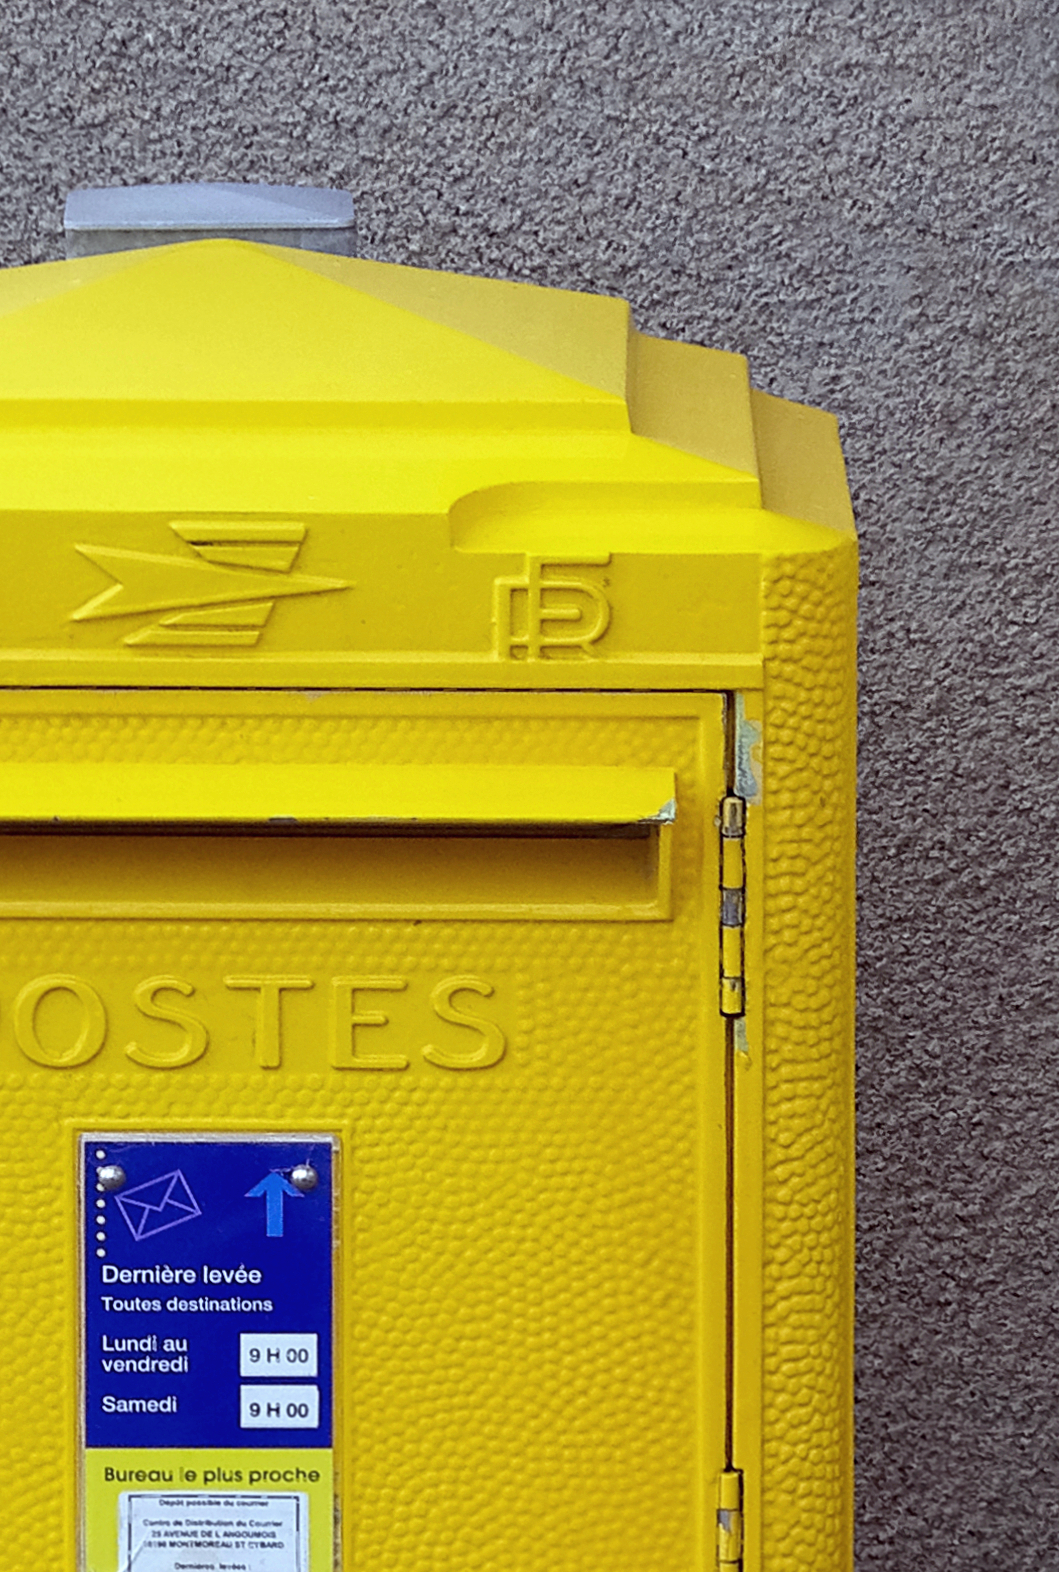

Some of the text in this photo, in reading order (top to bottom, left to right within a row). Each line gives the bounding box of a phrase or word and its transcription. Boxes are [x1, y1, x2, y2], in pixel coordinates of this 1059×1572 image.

[101, 1263, 262, 1284] Dernière levée
[101, 1296, 274, 1312] Toutes destinations
[102, 1335, 188, 1352] Lundi au
[249, 1348, 309, 1363] 9 H 00
[101, 1356, 189, 1372] vendredi
[101, 1396, 178, 1413] Samedi
[249, 1403, 309, 1418] 9 H 00
[104, 1467, 321, 1485] Bureau le plus proche
[163, 1530, 199, 1538] AVENUE
[201, 1530, 213, 1539] DE
